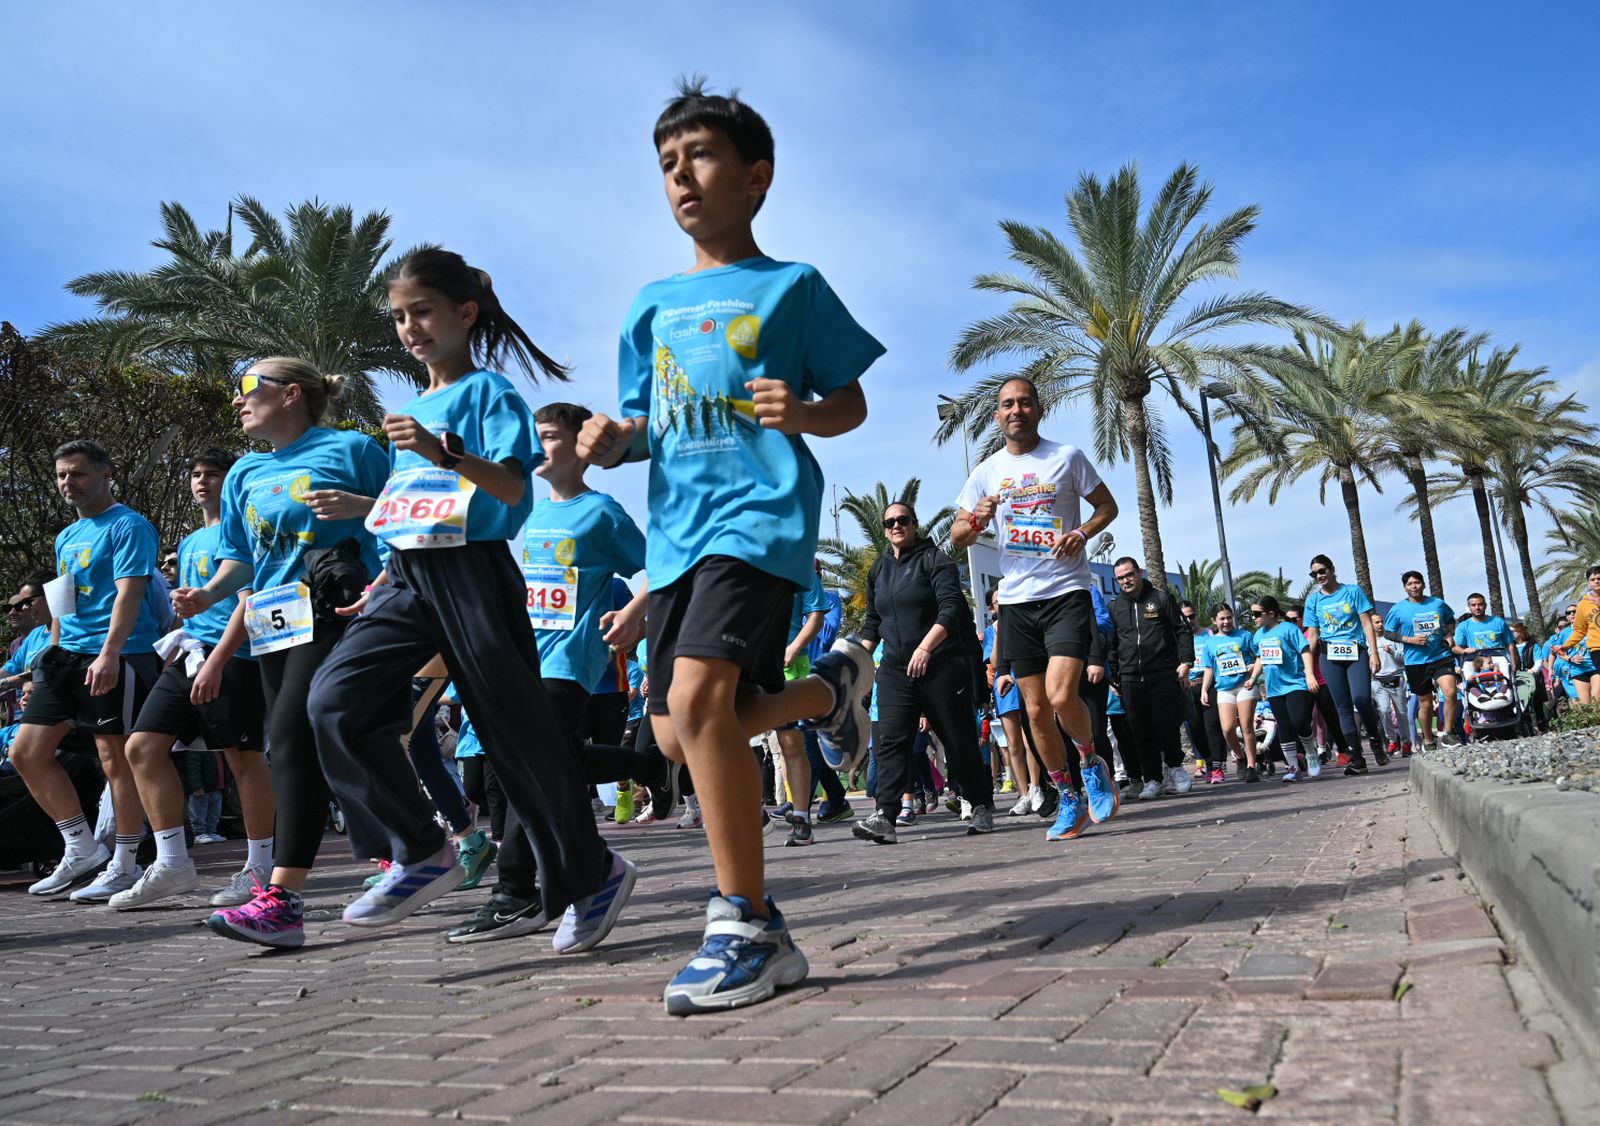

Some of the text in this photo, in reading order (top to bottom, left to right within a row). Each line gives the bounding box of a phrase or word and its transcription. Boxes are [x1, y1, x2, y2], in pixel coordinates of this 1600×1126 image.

[707, 299, 754, 310] Fashion
[1009, 528, 1056, 548] 2163
[271, 608, 286, 631] 5
[1333, 646, 1352, 654] 285
[1221, 659, 1239, 669] 284
